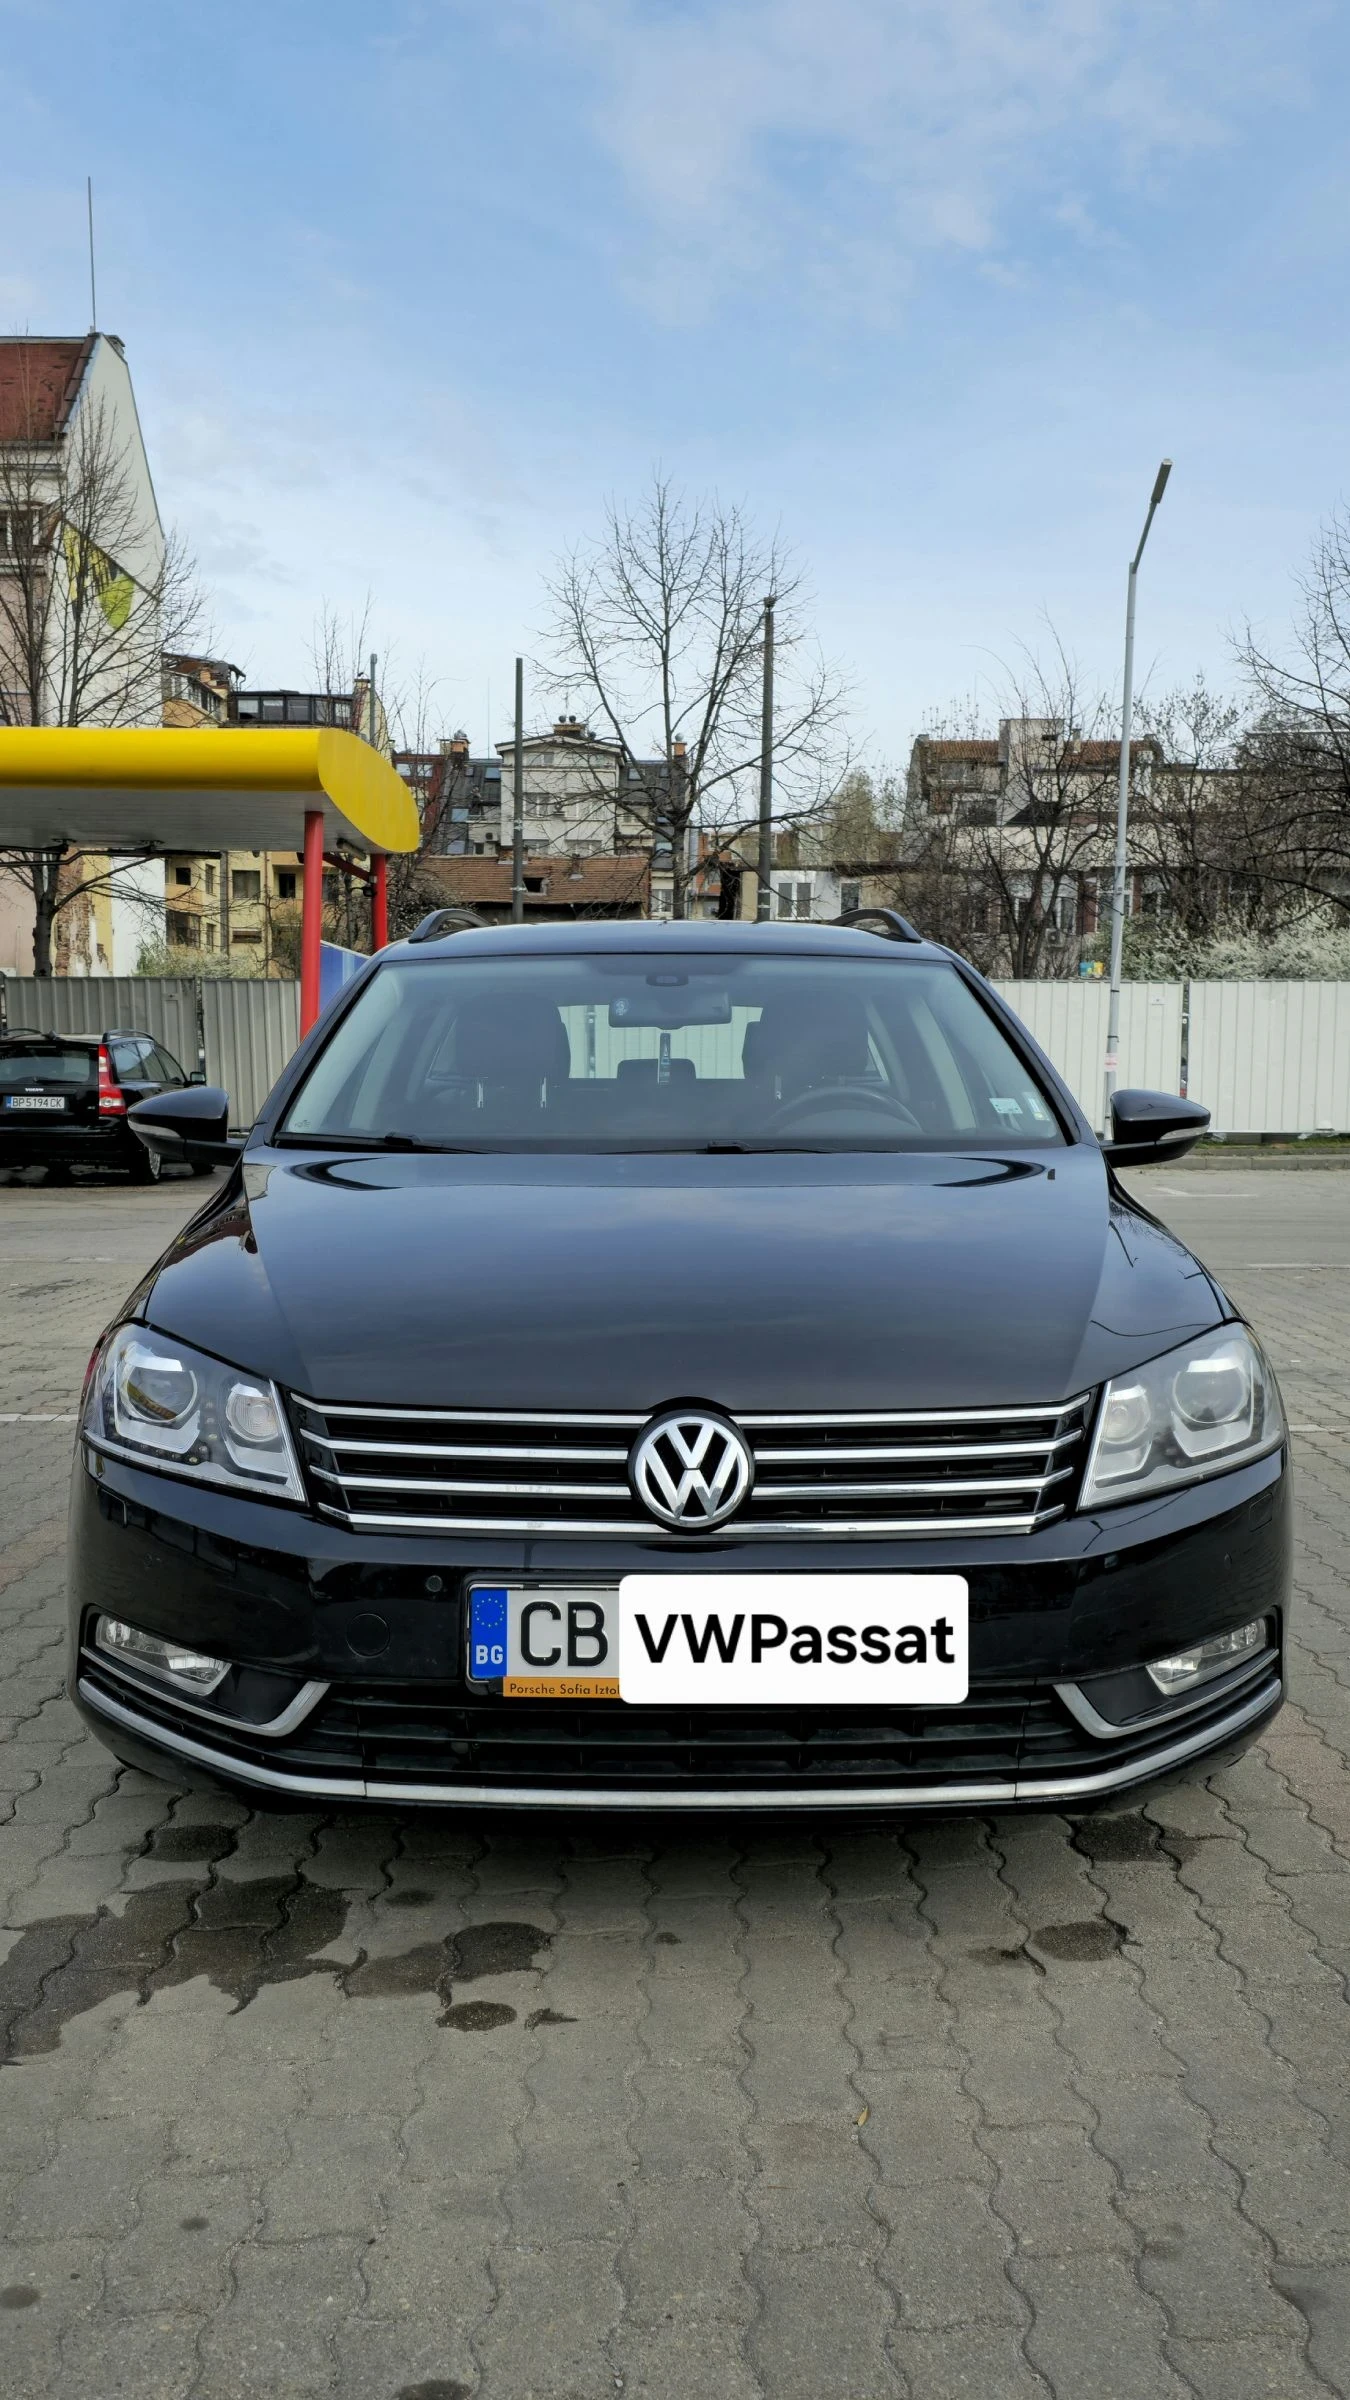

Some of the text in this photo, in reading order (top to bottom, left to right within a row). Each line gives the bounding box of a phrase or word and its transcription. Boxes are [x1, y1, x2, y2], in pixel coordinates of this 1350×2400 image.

[636, 1417, 748, 1524] VW
[475, 1644, 504, 1665] BG
[520, 1600, 609, 1667] CB
[509, 1683, 556, 1694] Porsche
[560, 1683, 591, 1695] Sofia
